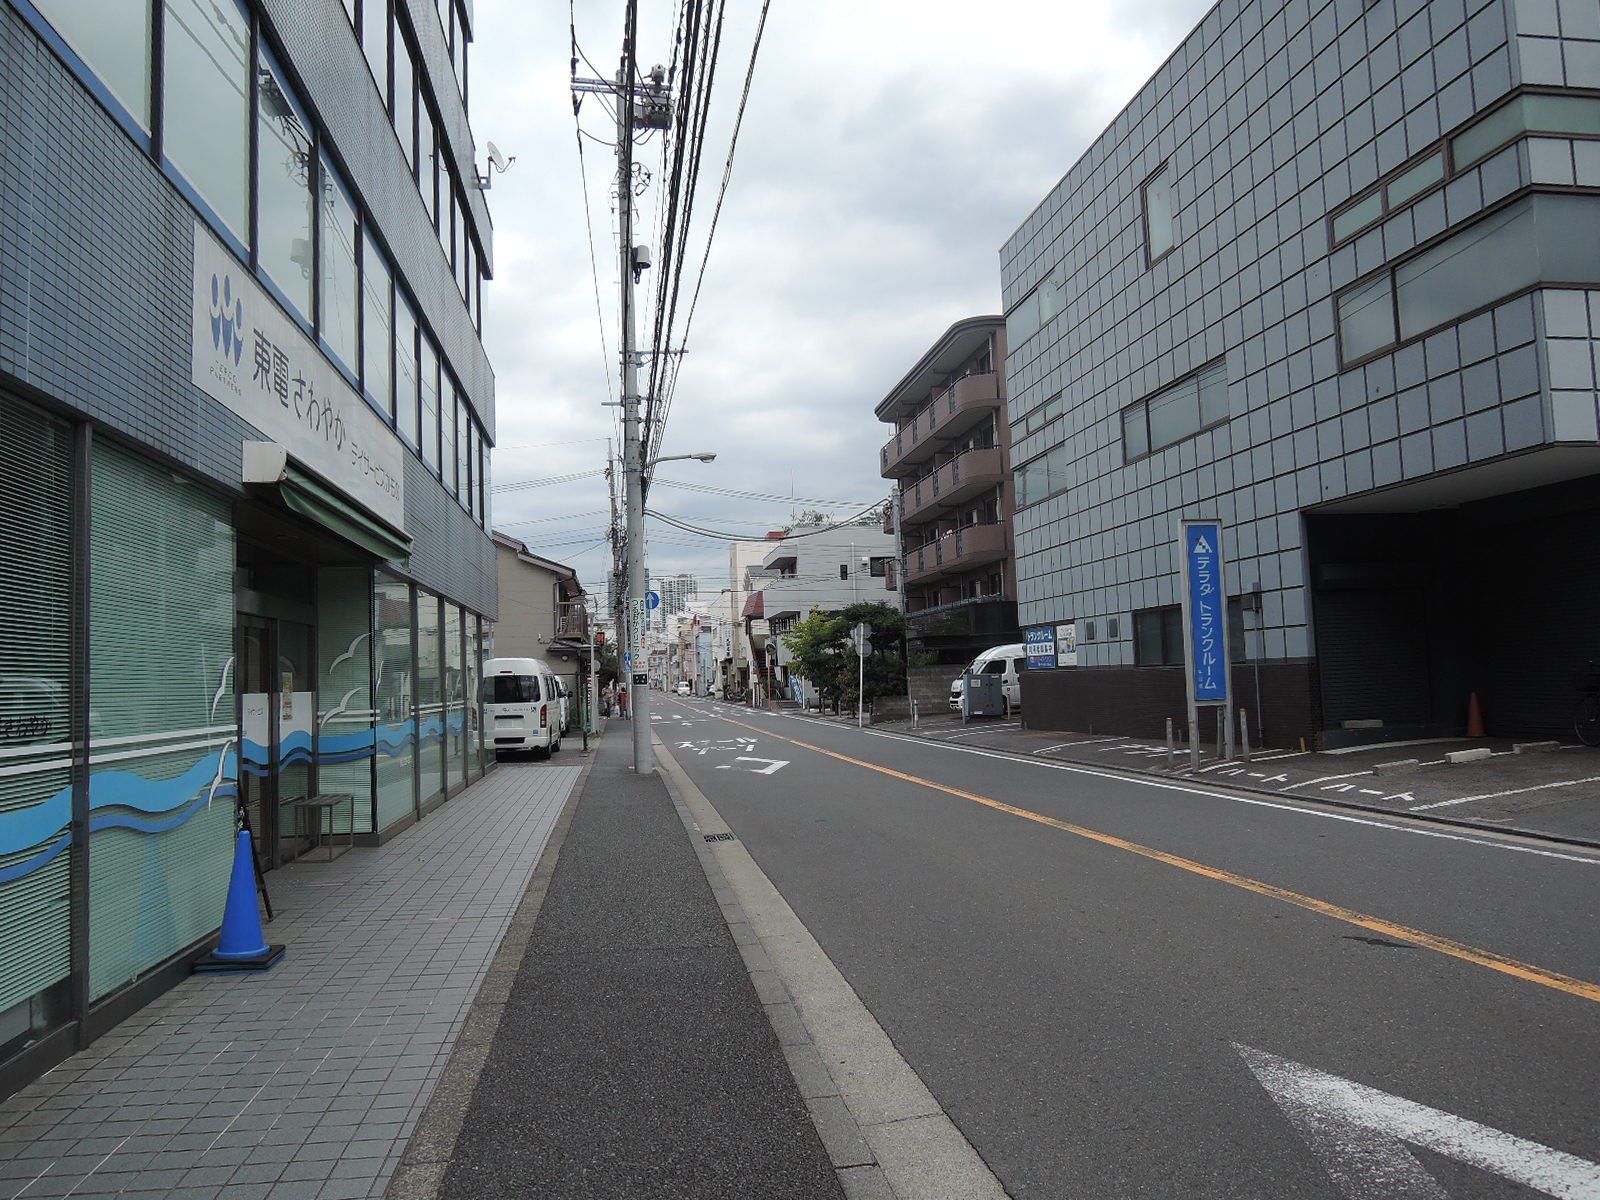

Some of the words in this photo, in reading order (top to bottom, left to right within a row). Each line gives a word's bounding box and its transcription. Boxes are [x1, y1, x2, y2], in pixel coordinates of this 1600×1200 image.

[253, 327, 346, 451] 東電さわやか
[1197, 556, 1215, 596] テラダ
[1199, 600, 1217, 690] トランクルーム
